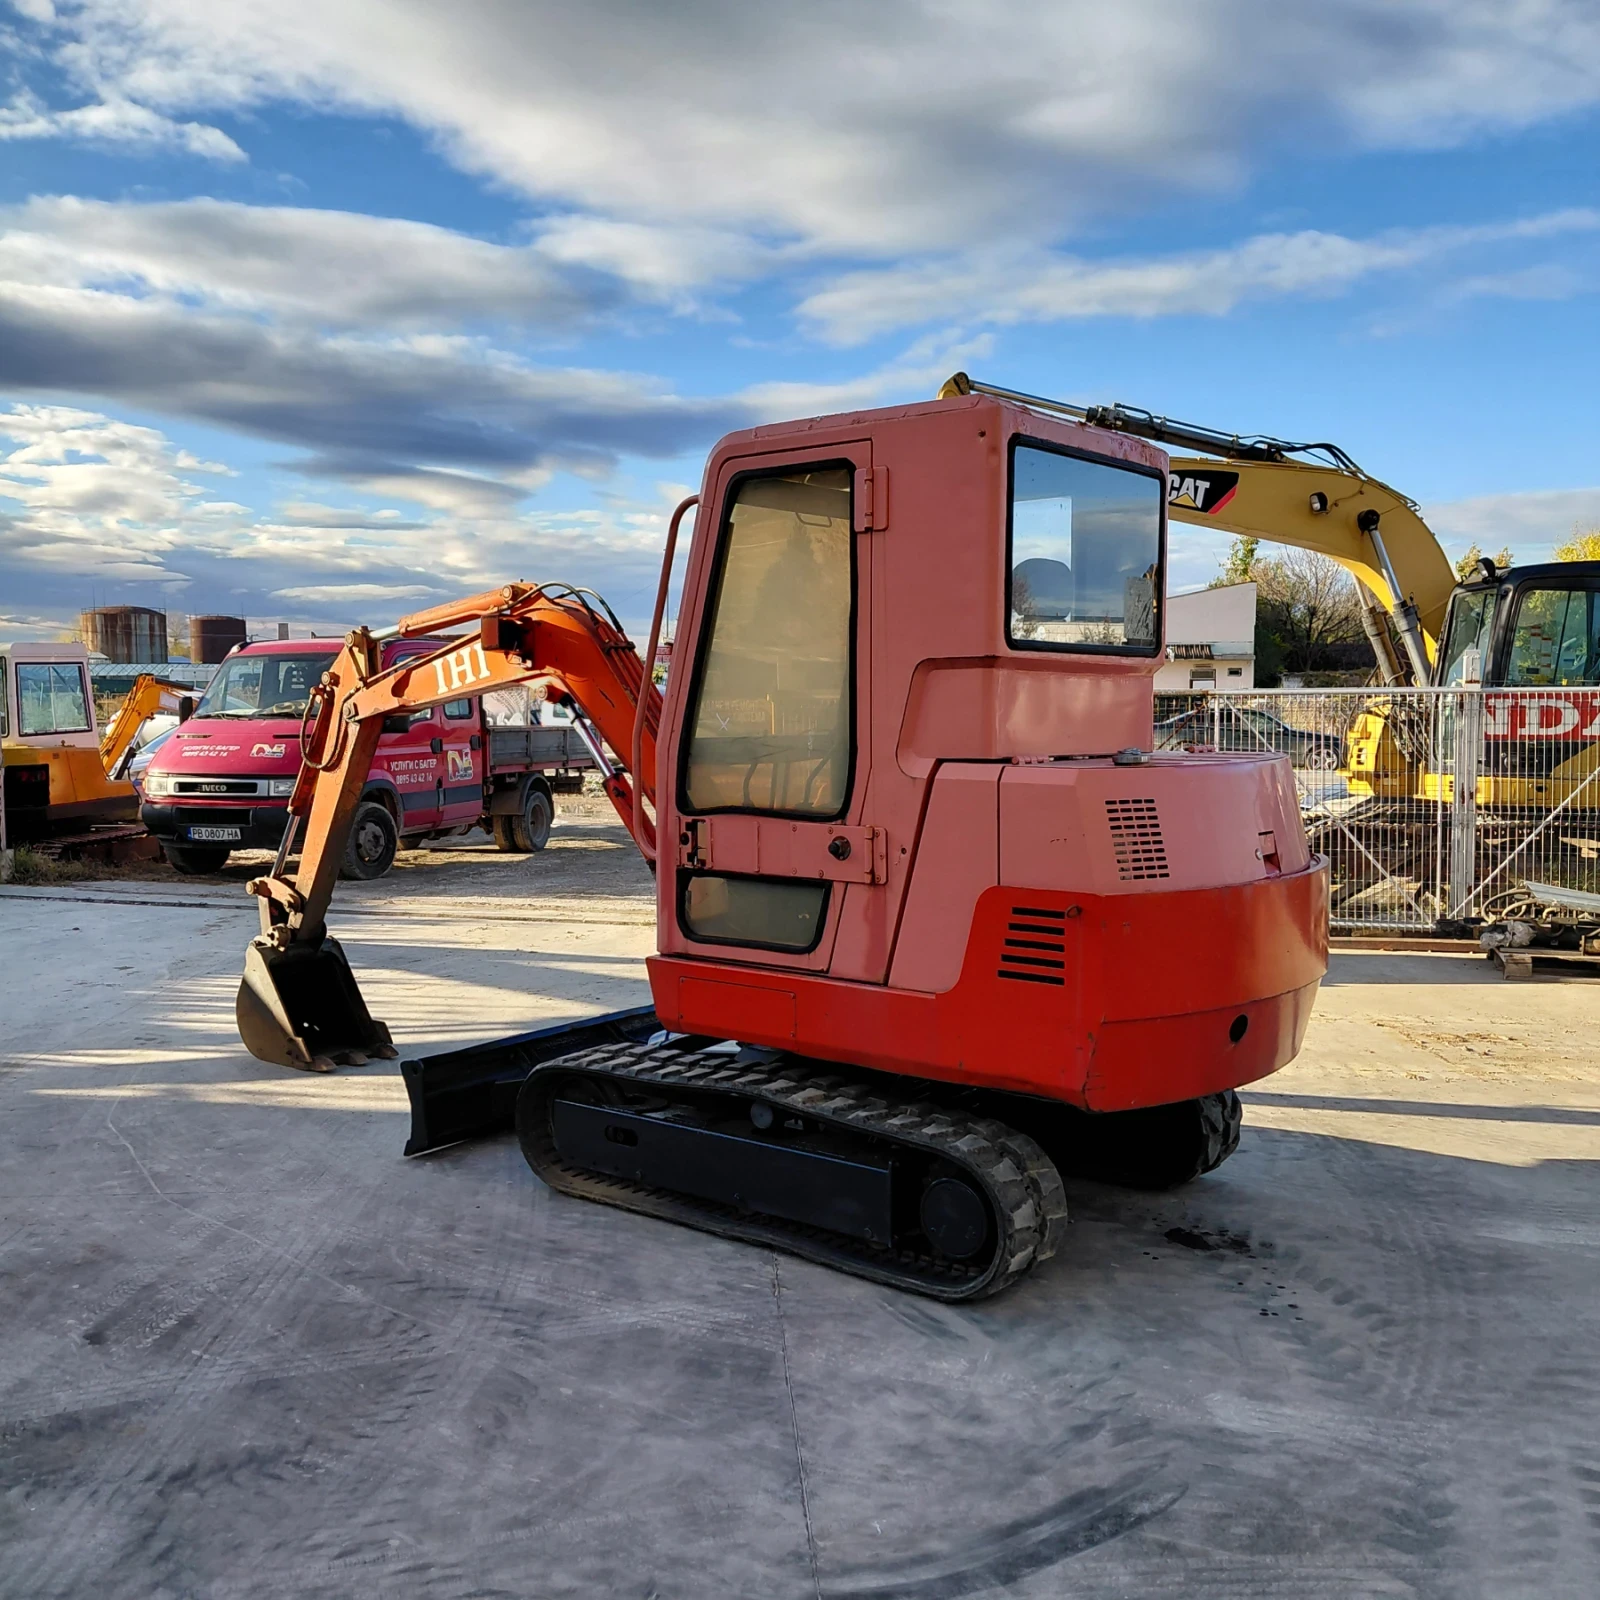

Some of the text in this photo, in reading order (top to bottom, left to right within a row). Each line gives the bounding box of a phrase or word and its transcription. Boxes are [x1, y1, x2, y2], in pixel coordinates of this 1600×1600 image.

[1169, 473, 1210, 509] CAT
[431, 642, 491, 695] IHI
[390, 759, 437, 771] УСЛУГИ С БАГЕР
[426, 772, 433, 782] 16
[202, 784, 227, 792] IVECO
[205, 829, 225, 839] 0807
